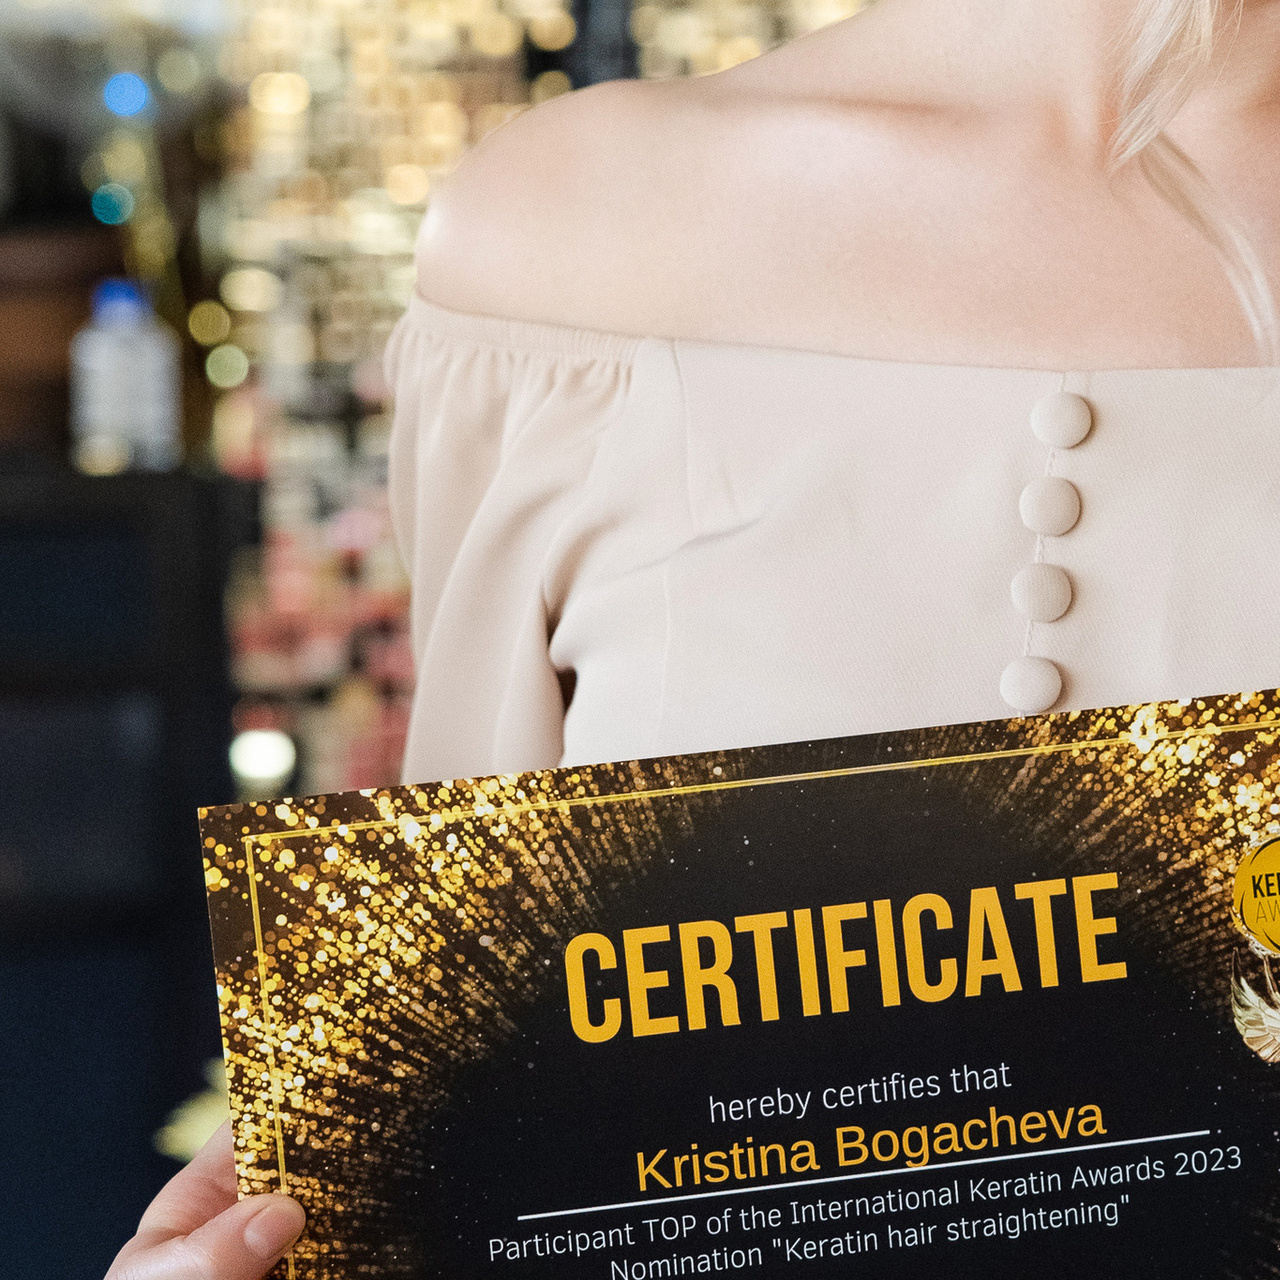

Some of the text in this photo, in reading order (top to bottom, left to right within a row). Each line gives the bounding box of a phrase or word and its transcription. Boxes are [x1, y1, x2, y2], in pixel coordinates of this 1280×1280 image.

[564, 872, 1128, 1044] CERTIFICATE
[708, 1062, 1013, 1123] hereby certifies that
[636, 1103, 1107, 1192] Kristina Bogacheva
[488, 1146, 1242, 1262] Participant TOP of the International Keratin Awards 2023
[772, 1228, 879, 1262] "Keratin
[888, 1222, 938, 1249] hair
[946, 1194, 1130, 1242] straightening"
